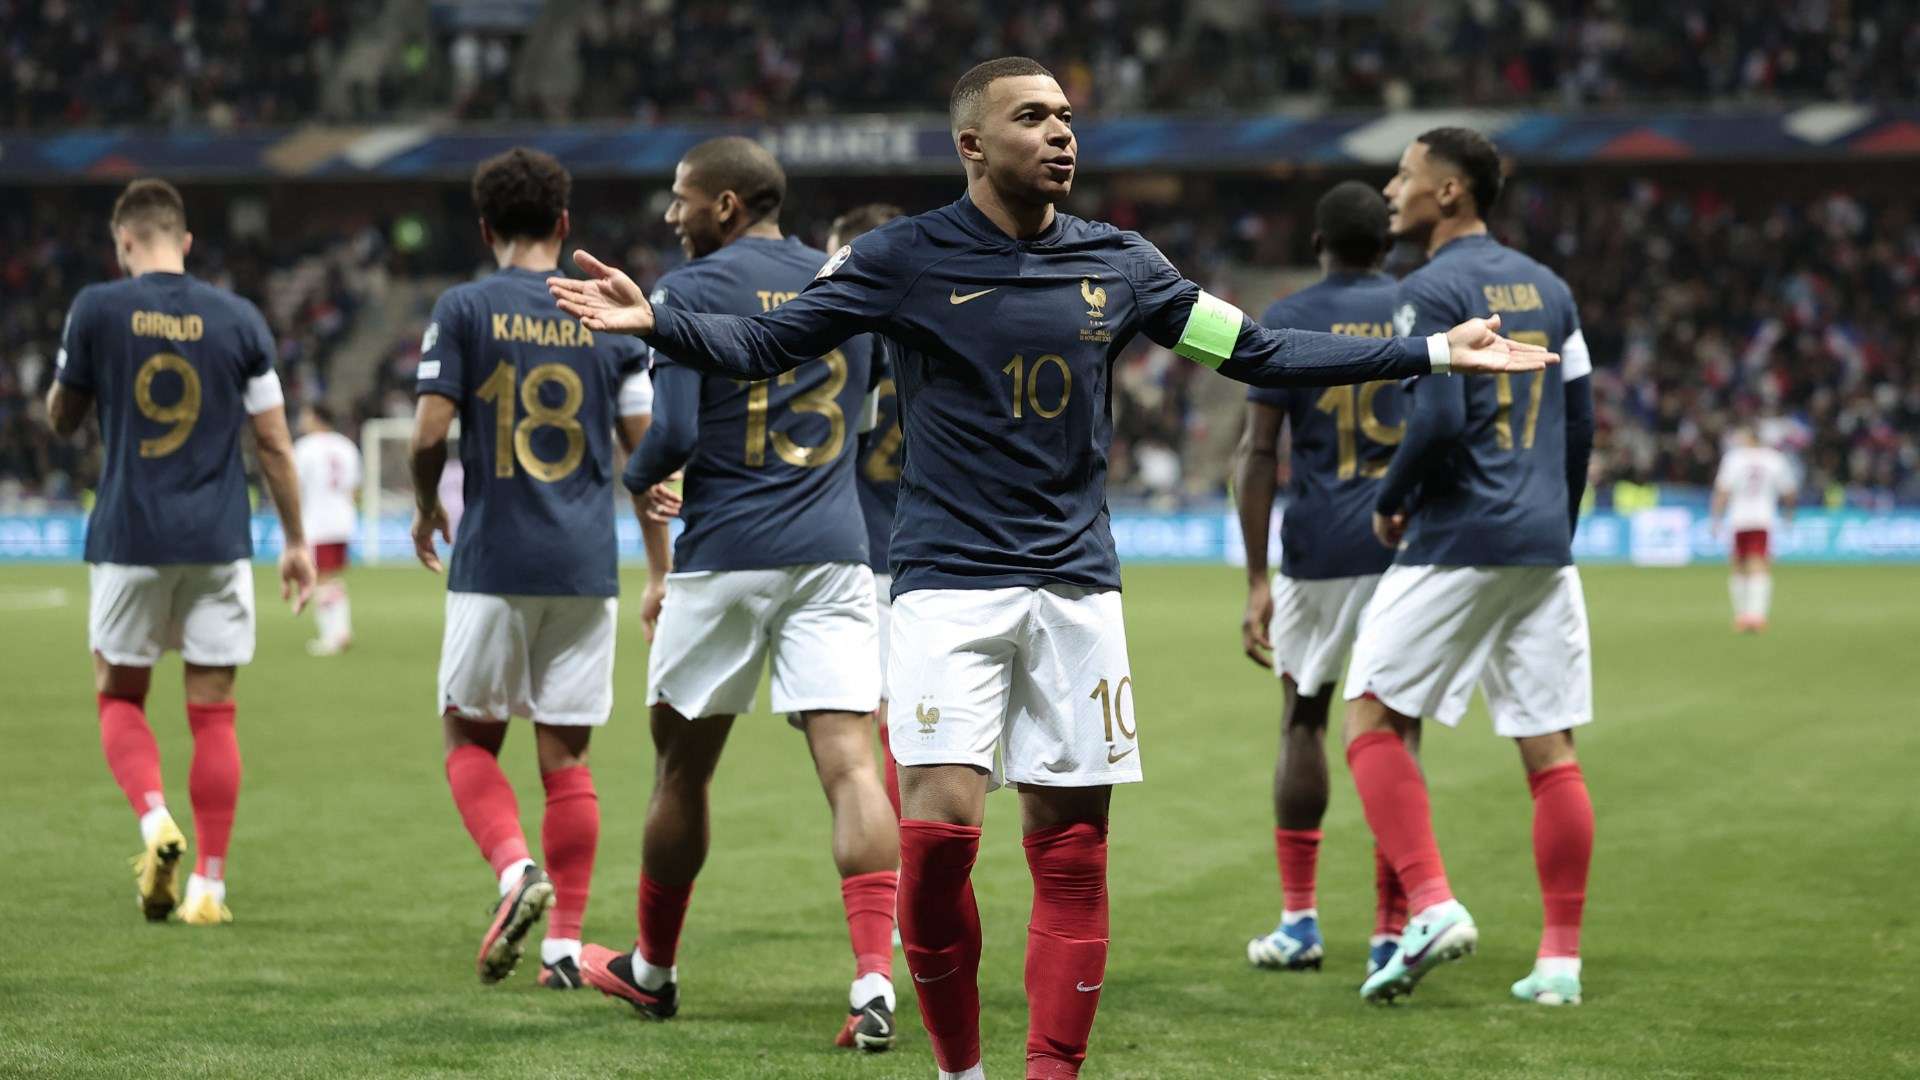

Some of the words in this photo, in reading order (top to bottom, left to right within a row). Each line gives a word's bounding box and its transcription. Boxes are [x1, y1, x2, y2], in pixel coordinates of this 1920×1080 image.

[131, 310, 203, 341] GIROUD
[491, 313, 595, 347] KAMARA
[1483, 283, 1544, 312] SALIBA
[134, 353, 202, 459] 9
[738, 348, 848, 468] 13
[1002, 353, 1073, 419] 10
[1488, 330, 1550, 450] 17
[475, 359, 586, 483] 18
[1089, 676, 1137, 741] 10
